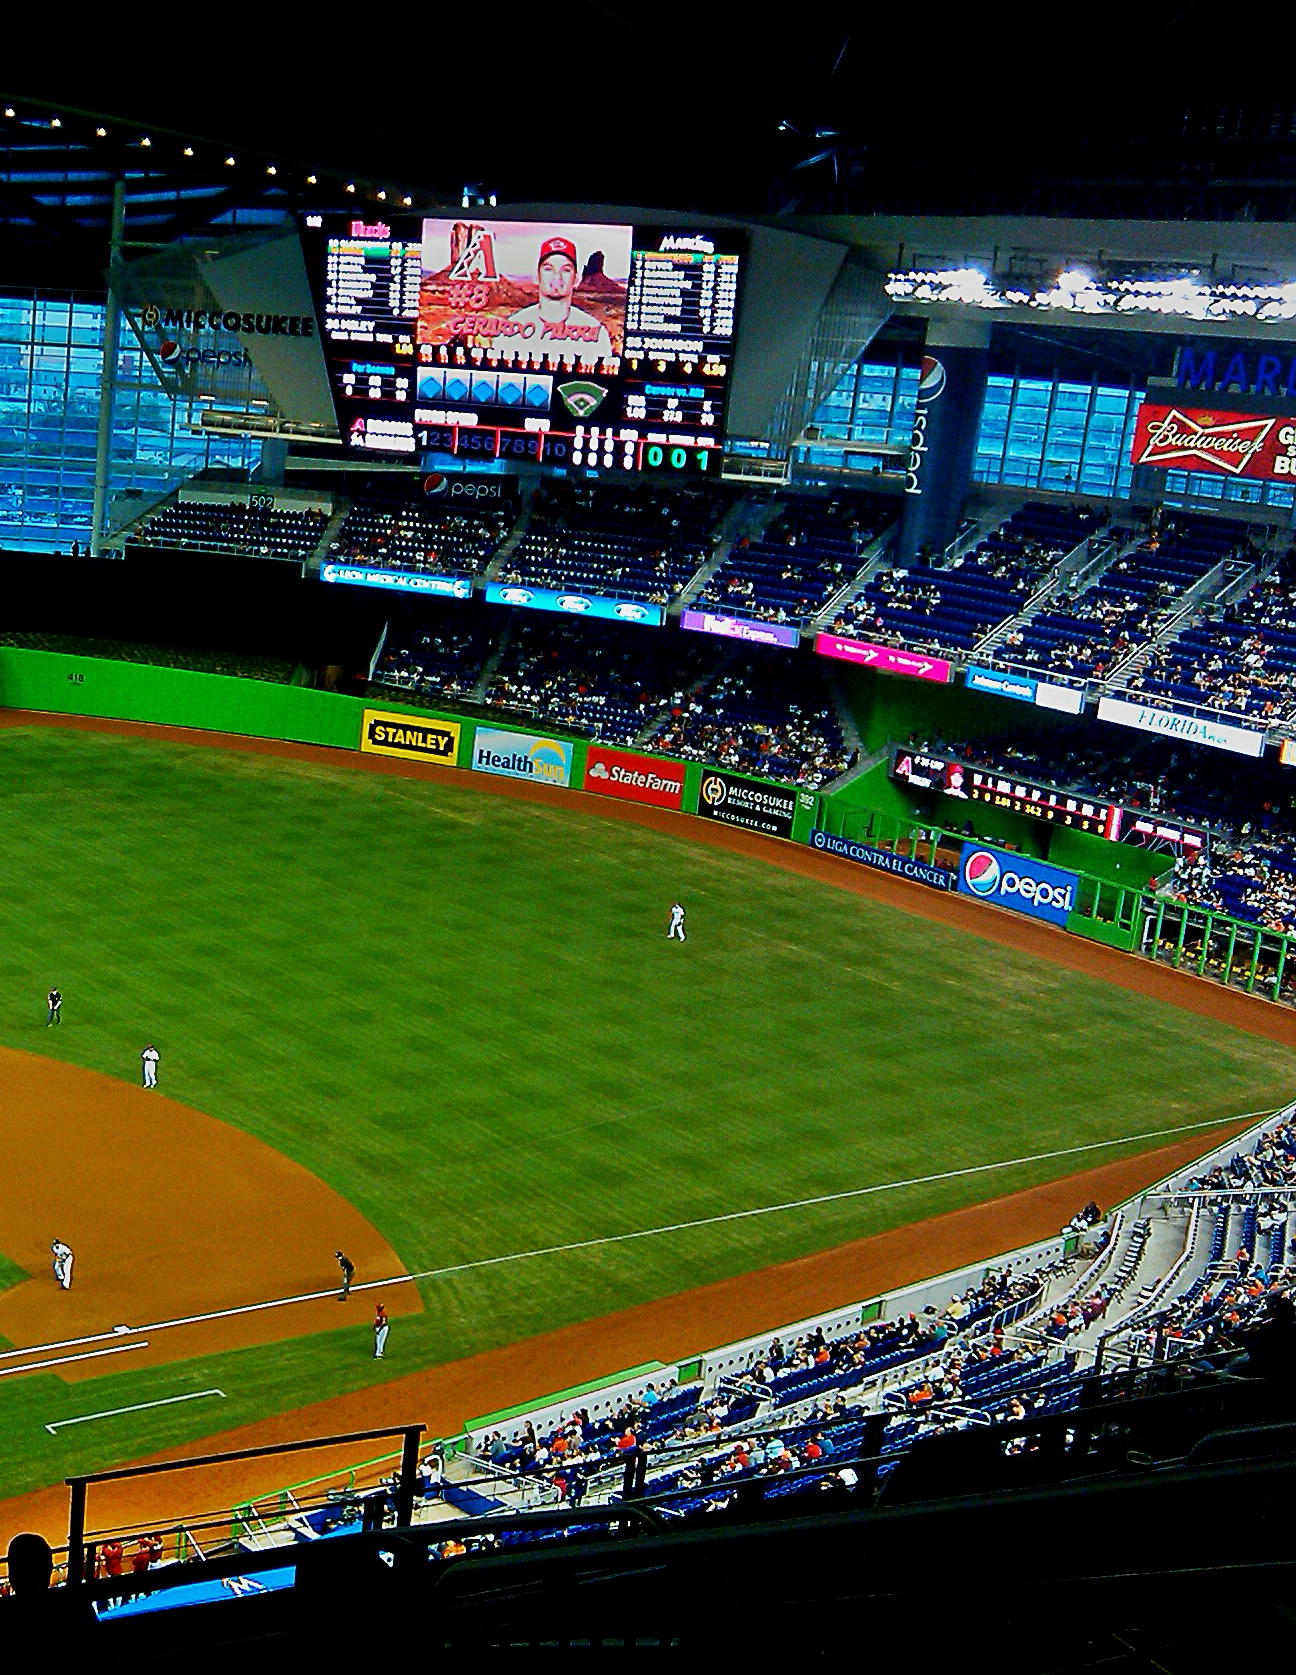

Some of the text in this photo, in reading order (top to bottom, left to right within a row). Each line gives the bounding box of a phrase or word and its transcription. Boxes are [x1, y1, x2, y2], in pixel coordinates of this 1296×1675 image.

[448, 283, 489, 310] #8
[165, 308, 313, 336] MICCOSUKEE
[451, 316, 602, 342] GERARDO PARRA
[185, 347, 253, 368] pepsi
[1176, 347, 1296, 397] MAR
[417, 431, 427, 446] 1
[430, 431, 441, 446] 2
[458, 434, 469, 448] 4
[470, 435, 481, 449] 5
[484, 436, 494, 450] 6
[501, 438, 511, 452] 7
[513, 439, 525, 453] 8
[527, 440, 538, 454] 9
[545, 442, 566, 457] 10
[1147, 422, 1263, 453] Budweiser
[648, 447, 708, 470] 0 0 1
[905, 408, 930, 494] pepsi
[251, 495, 273, 507] 502
[452, 482, 501, 499] pepsi
[374, 726, 448, 751] STANLEY
[729, 786, 794, 810] MICCOSUKEE
[799, 793, 814, 805] 392
[713, 810, 777, 831] MICCOSUKEE.COM
[827, 838, 946, 887] LIGA CONTRA EL CANCER
[1001, 870, 1073, 912] pepsi
